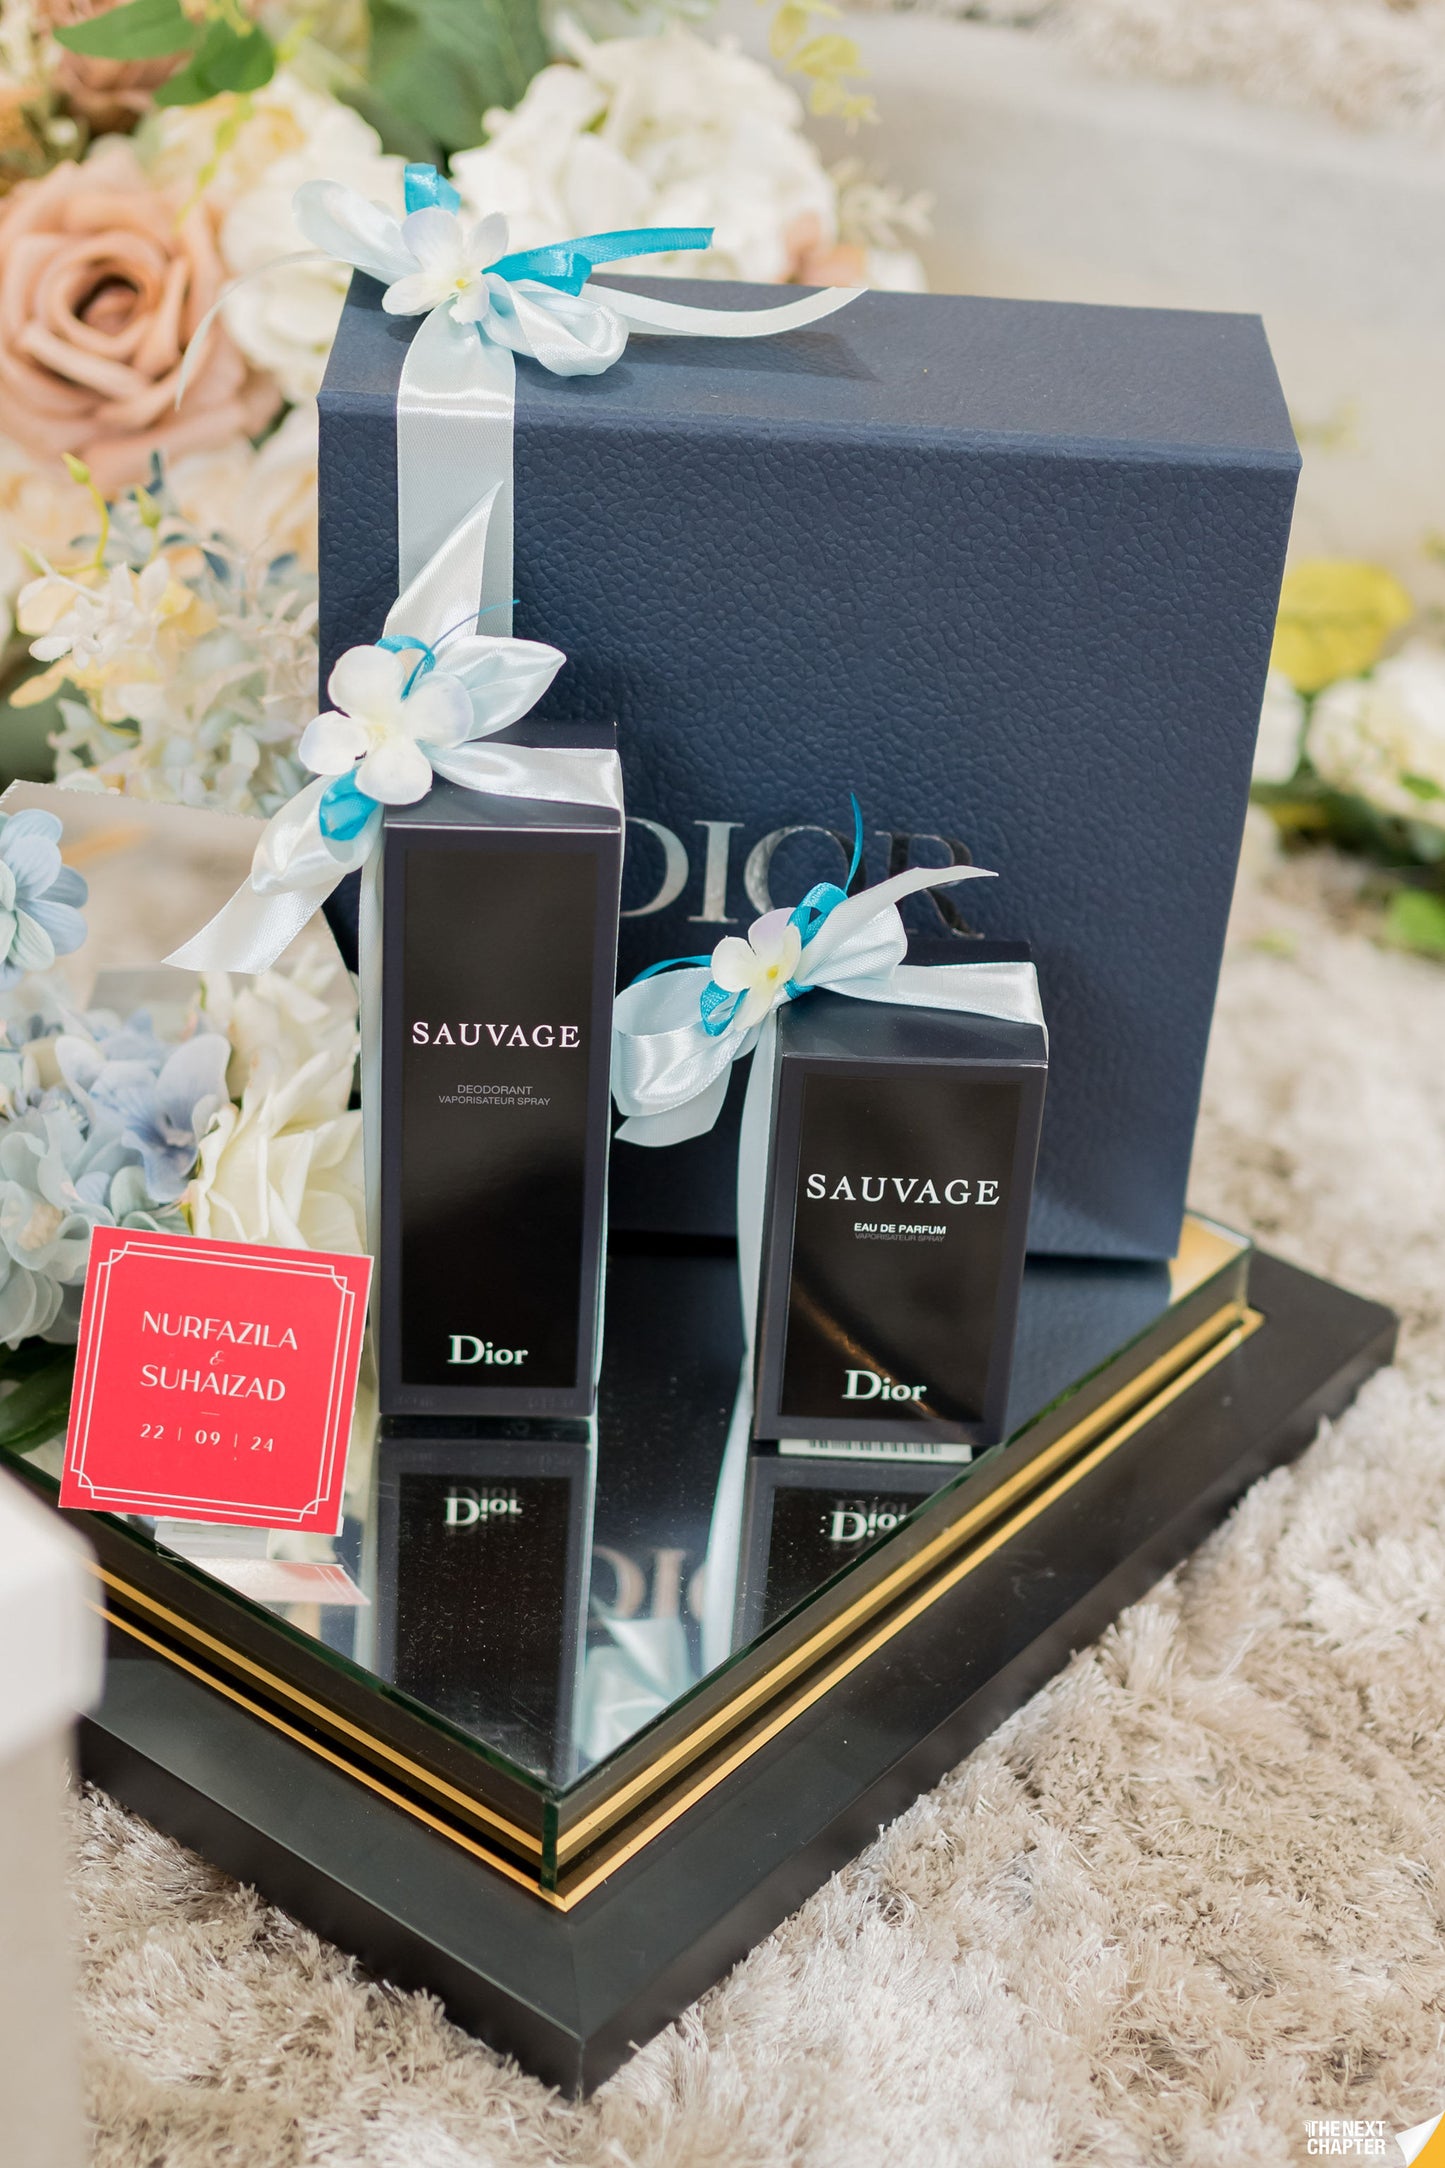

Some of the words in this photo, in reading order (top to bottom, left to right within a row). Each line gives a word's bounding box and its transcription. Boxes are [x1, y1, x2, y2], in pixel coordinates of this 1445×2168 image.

[412, 1021, 581, 1048] SAUVAGE
[438, 1095, 515, 1105] VAPORISATEUR
[517, 1097, 551, 1106] SPRAY
[457, 1084, 534, 1096] DEODORANT
[806, 1173, 1000, 1205] SAUVAGE
[854, 1222, 878, 1233] EAU
[880, 1224, 896, 1234] DE
[899, 1225, 947, 1235] PARFUM
[855, 1232, 916, 1242] VAPORISATEUR
[918, 1234, 945, 1243] SPRAY
[142, 1310, 298, 1351] NURFAZILA
[209, 1350, 225, 1366] &
[446, 1334, 529, 1365] Dior
[139, 1364, 286, 1402] SUHAIZAD
[841, 1369, 928, 1401] Dior
[139, 1423, 165, 1440] 22
[194, 1429, 221, 1446] 09
[250, 1436, 274, 1452] 24
